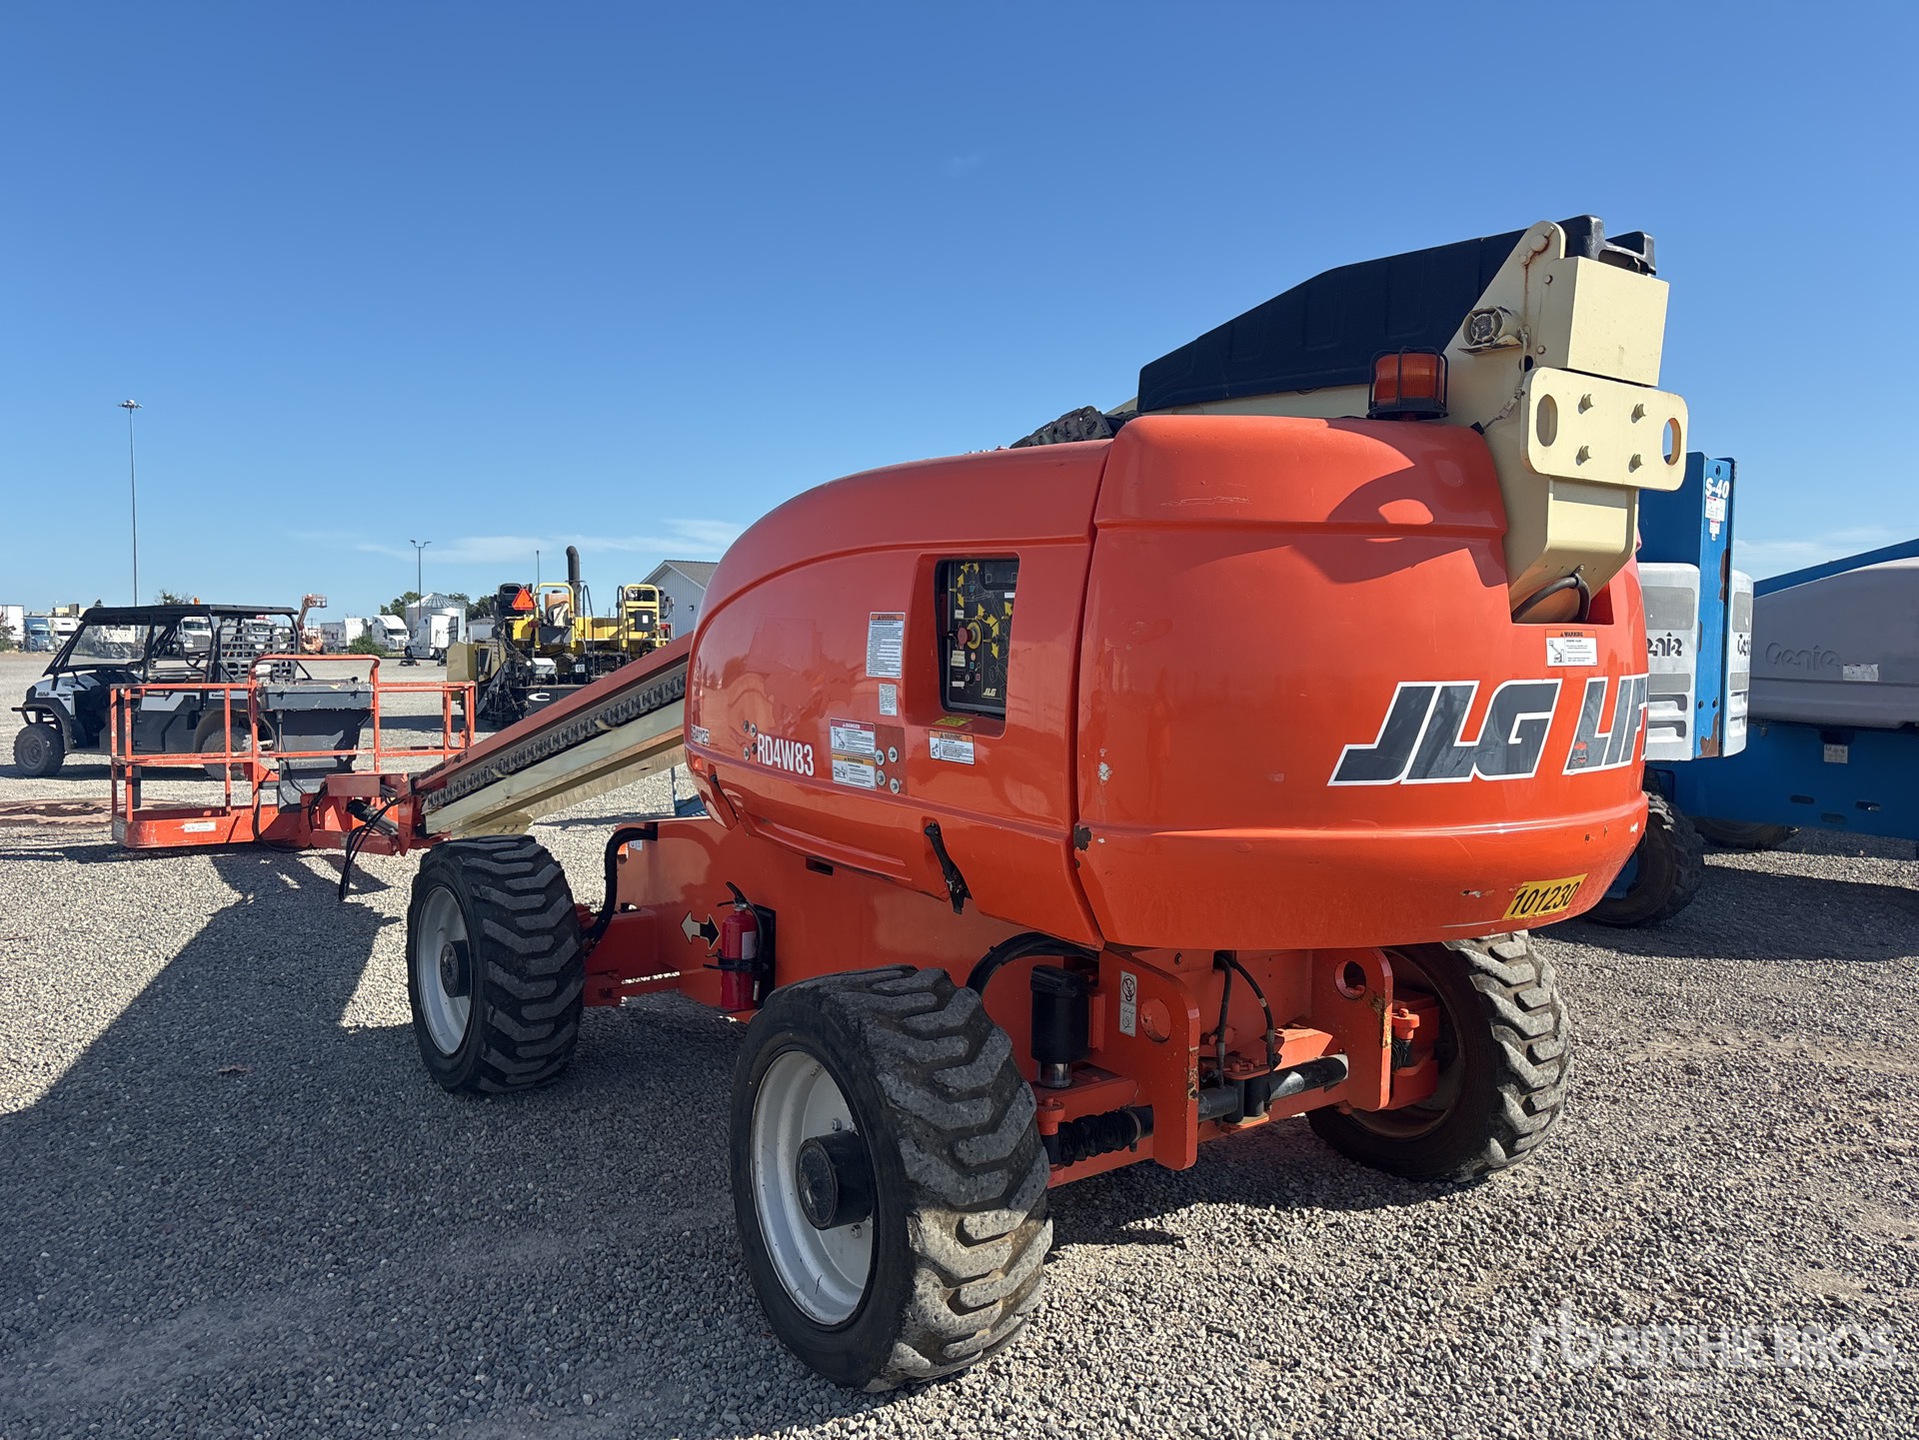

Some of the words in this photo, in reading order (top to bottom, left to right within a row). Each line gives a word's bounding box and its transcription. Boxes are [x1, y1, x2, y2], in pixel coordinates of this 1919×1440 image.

[1705, 477, 1730, 499] S-40
[1646, 631, 1683, 656] enie
[1765, 642, 1841, 672] Genie
[982, 687, 997, 697] JLG
[1327, 678, 1563, 787] JLG
[1562, 673, 1649, 776] LIF
[757, 732, 815, 777] RD4W83
[1510, 881, 1581, 915] 101230
